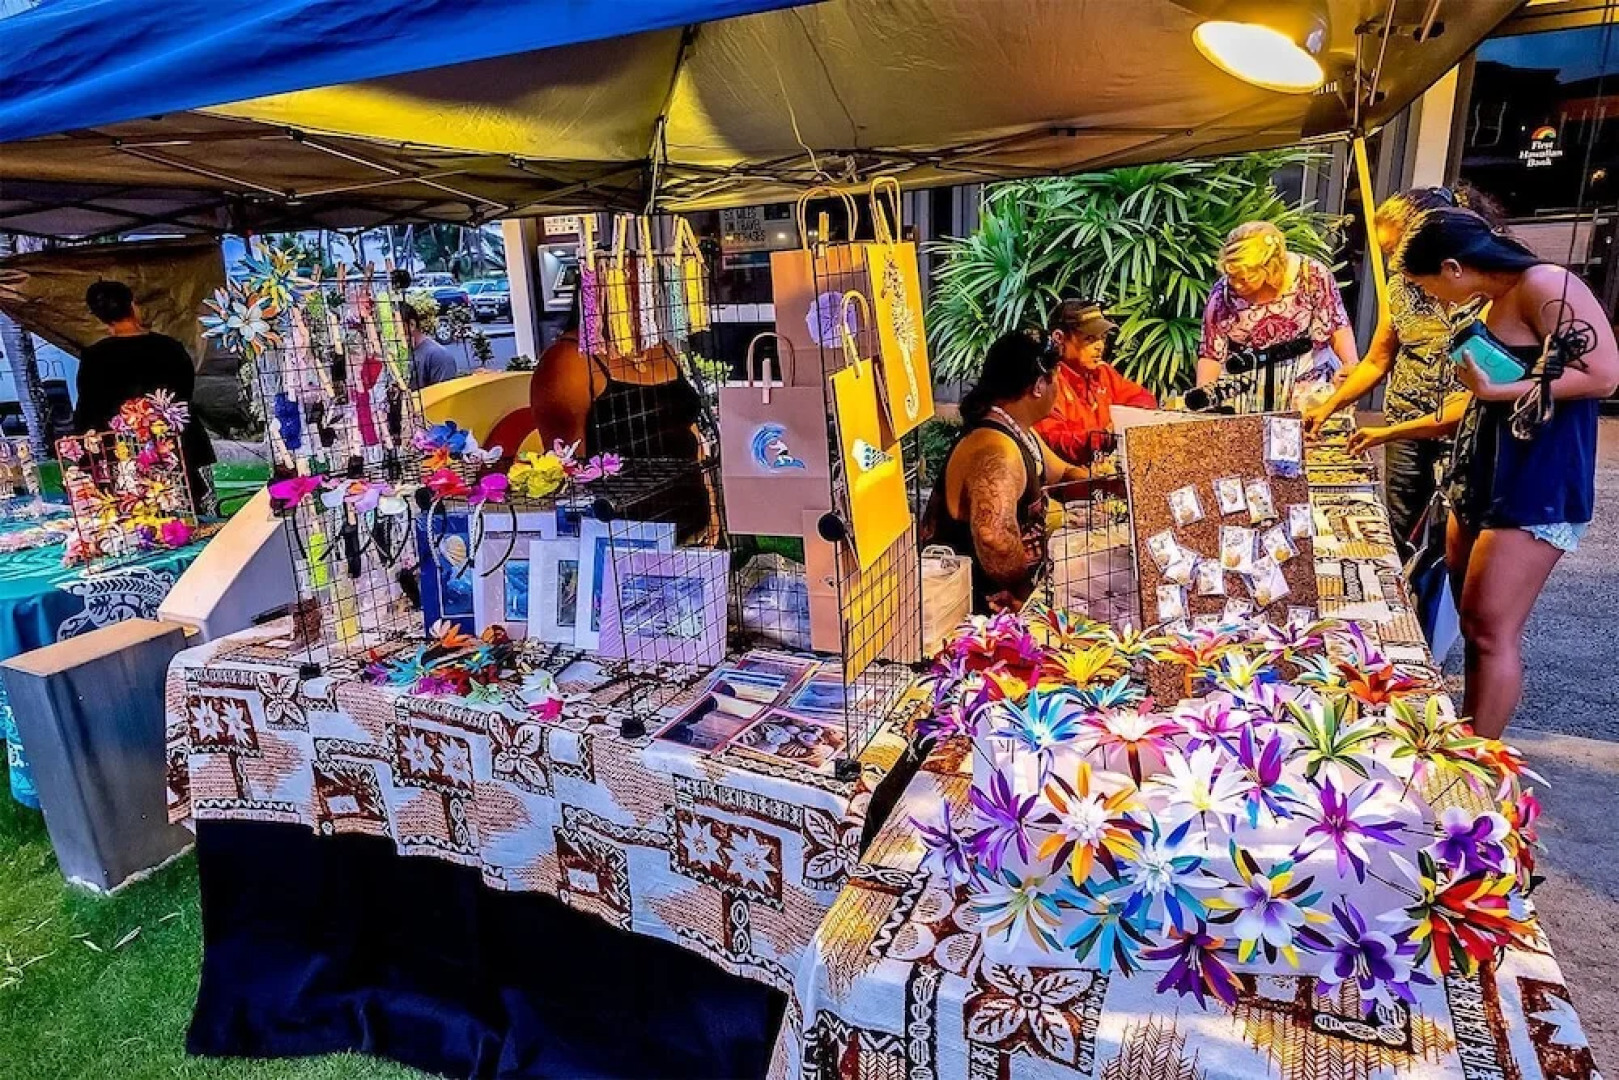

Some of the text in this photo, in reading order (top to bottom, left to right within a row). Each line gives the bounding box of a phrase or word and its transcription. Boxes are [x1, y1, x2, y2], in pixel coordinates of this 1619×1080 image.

[1531, 140, 1554, 149] First
[1518, 149, 1563, 159] Hawaiian
[1526, 157, 1552, 167] Bank
[736, 207, 757, 219] MILES
